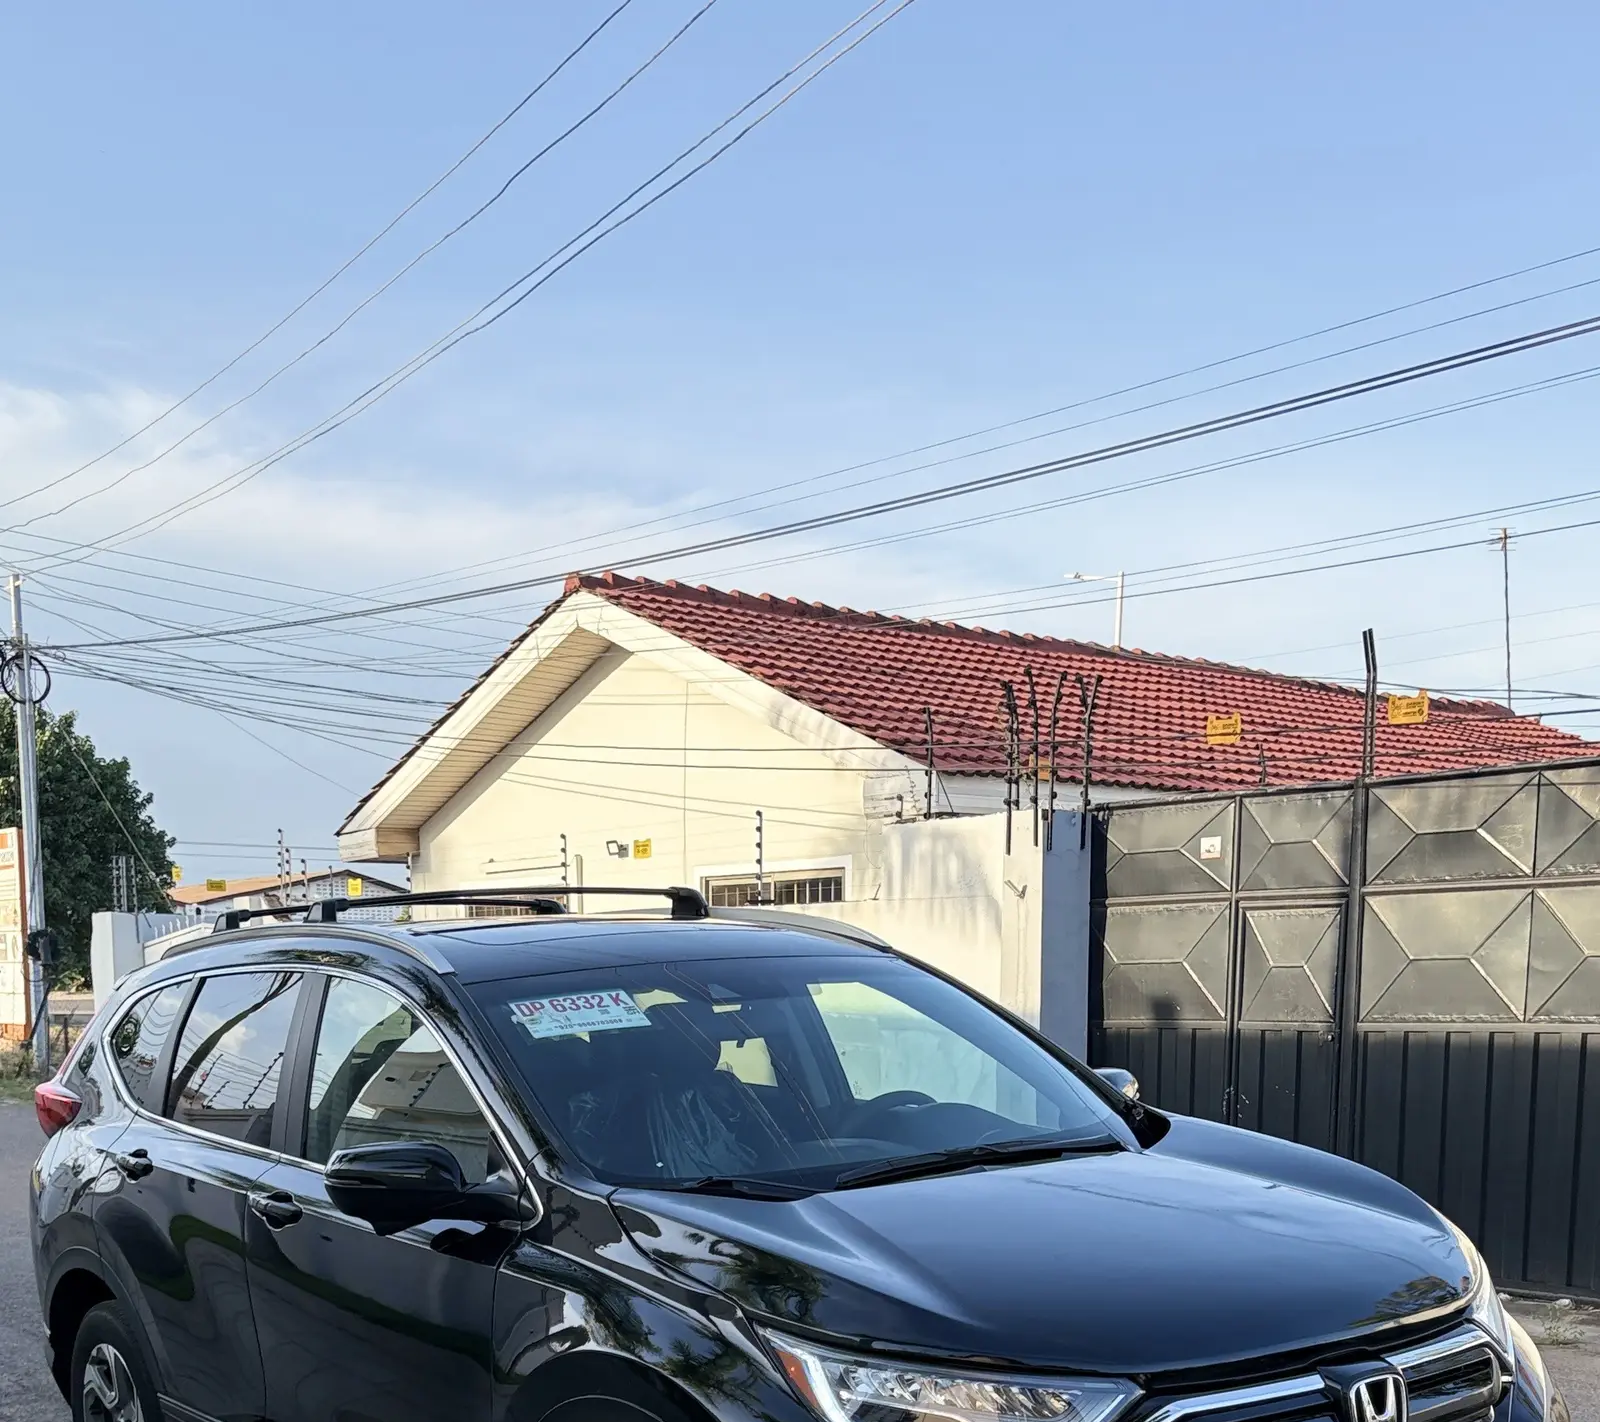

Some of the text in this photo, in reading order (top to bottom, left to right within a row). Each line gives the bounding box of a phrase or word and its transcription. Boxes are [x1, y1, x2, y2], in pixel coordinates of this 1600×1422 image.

[514, 992, 629, 1018] DP 6332 K
